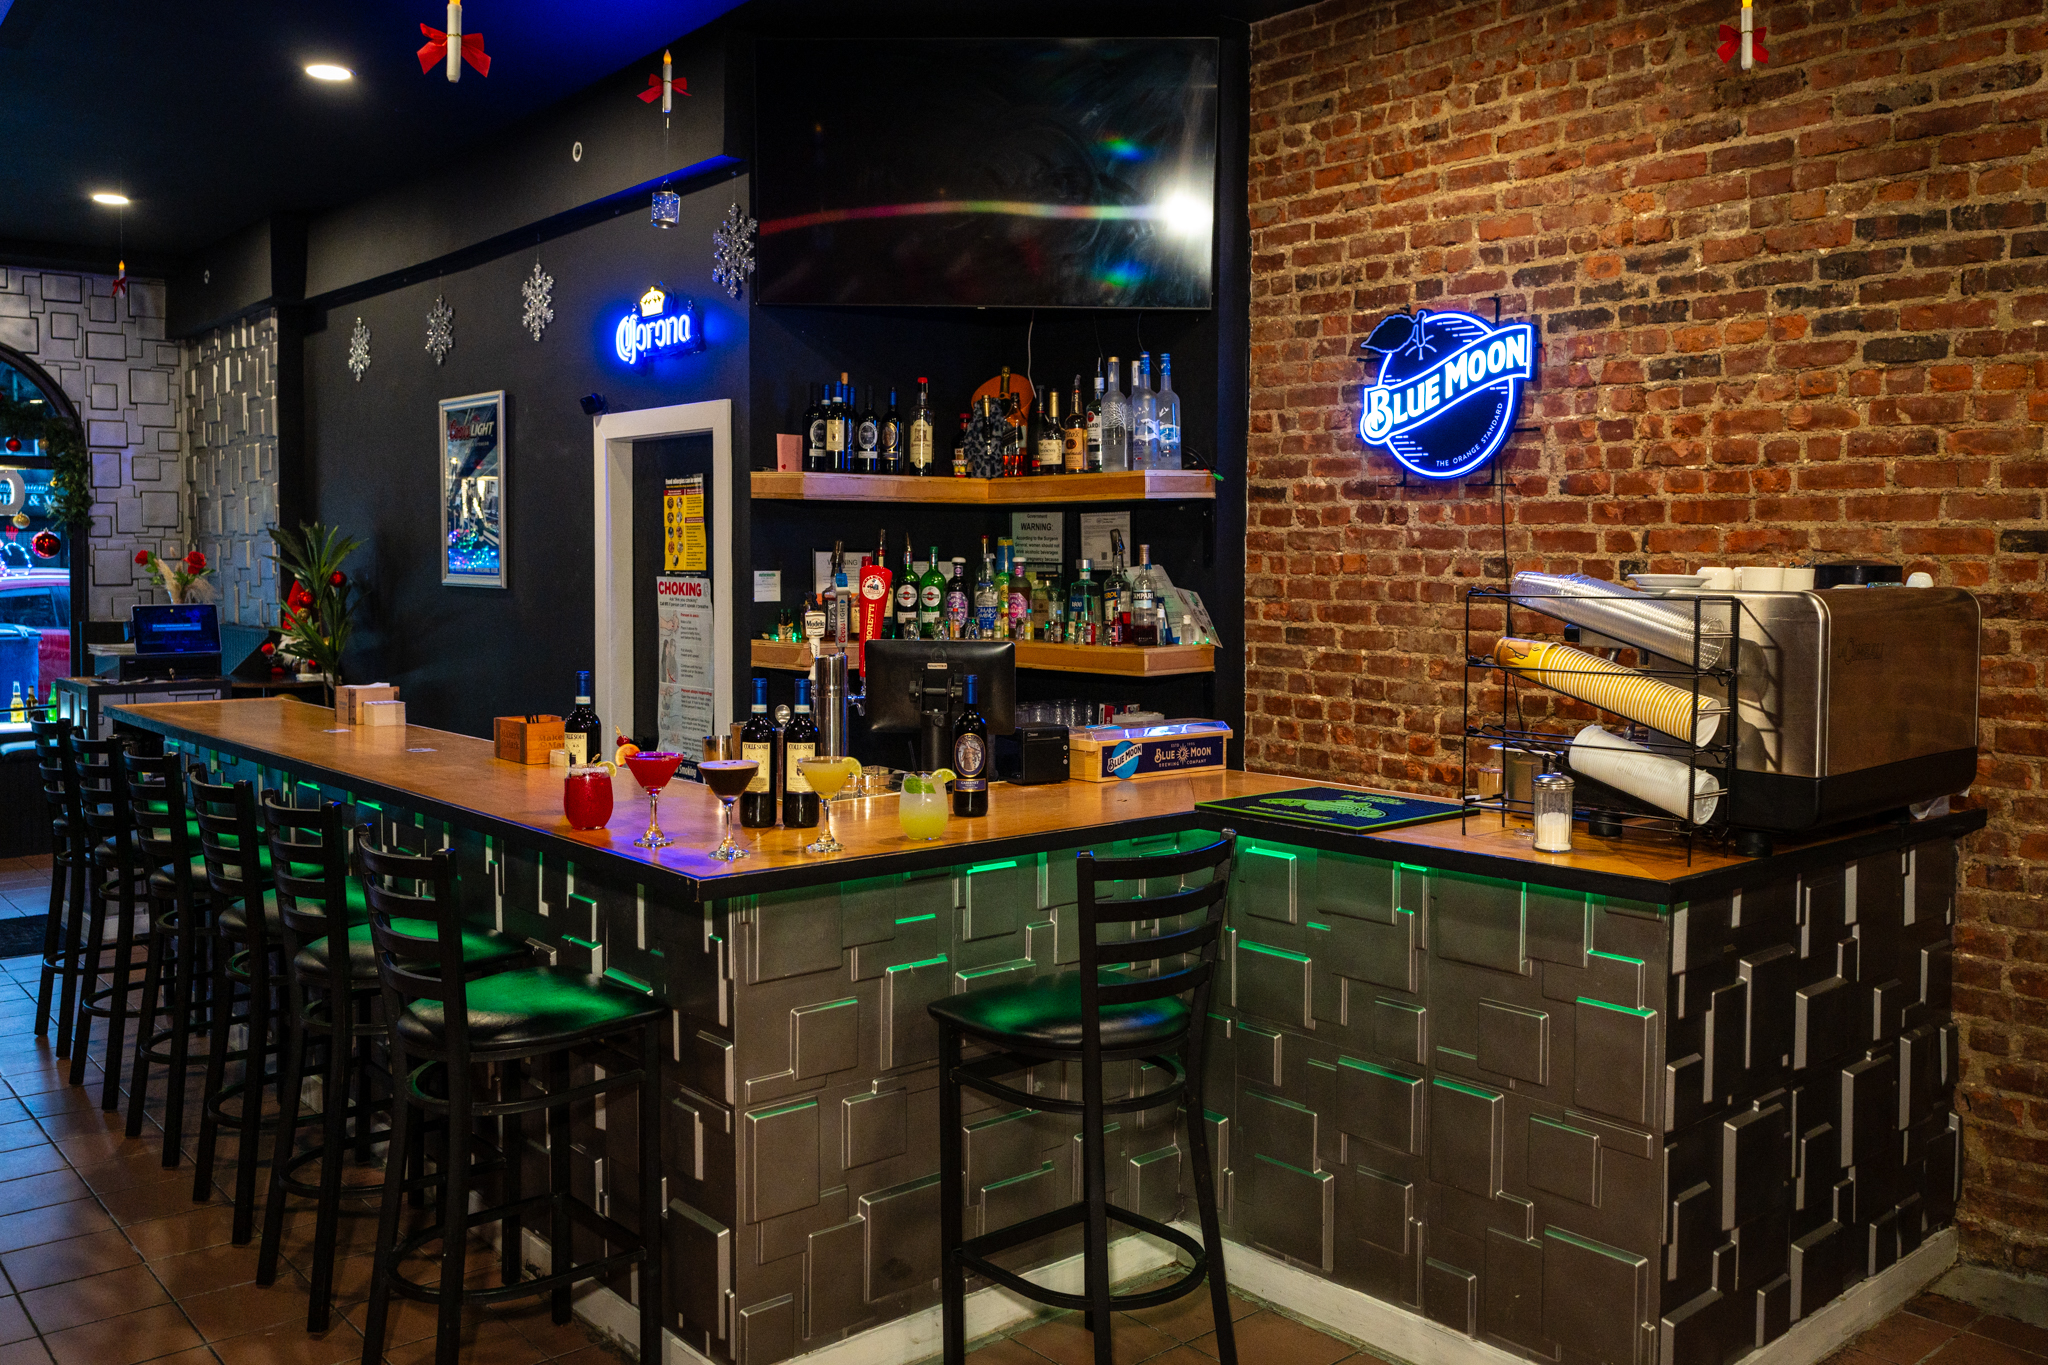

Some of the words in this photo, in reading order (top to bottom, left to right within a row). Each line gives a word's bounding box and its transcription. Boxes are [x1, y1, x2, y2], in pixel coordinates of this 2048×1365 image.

[616, 313, 691, 366] Corona
[1363, 373, 1441, 439] BLUE
[1444, 333, 1525, 400] MOON
[470, 421, 495, 438] LIGHT
[1436, 459, 1450, 468] THE
[1452, 444, 1481, 465] ORANGE
[1480, 402, 1504, 444] STANDARD
[1021, 523, 1054, 531] WARNING:
[658, 581, 702, 597] CHOKING
[806, 620, 825, 628] Modelo
[838, 623, 846, 644] Coors
[539, 734, 563, 742] Make
[1107, 756, 1125, 773] BLUE
[1125, 745, 1142, 761] MOON
[1154, 747, 1176, 764] BLUE
[1190, 746, 1212, 757] MOON
[679, 764, 697, 778] Smoking
